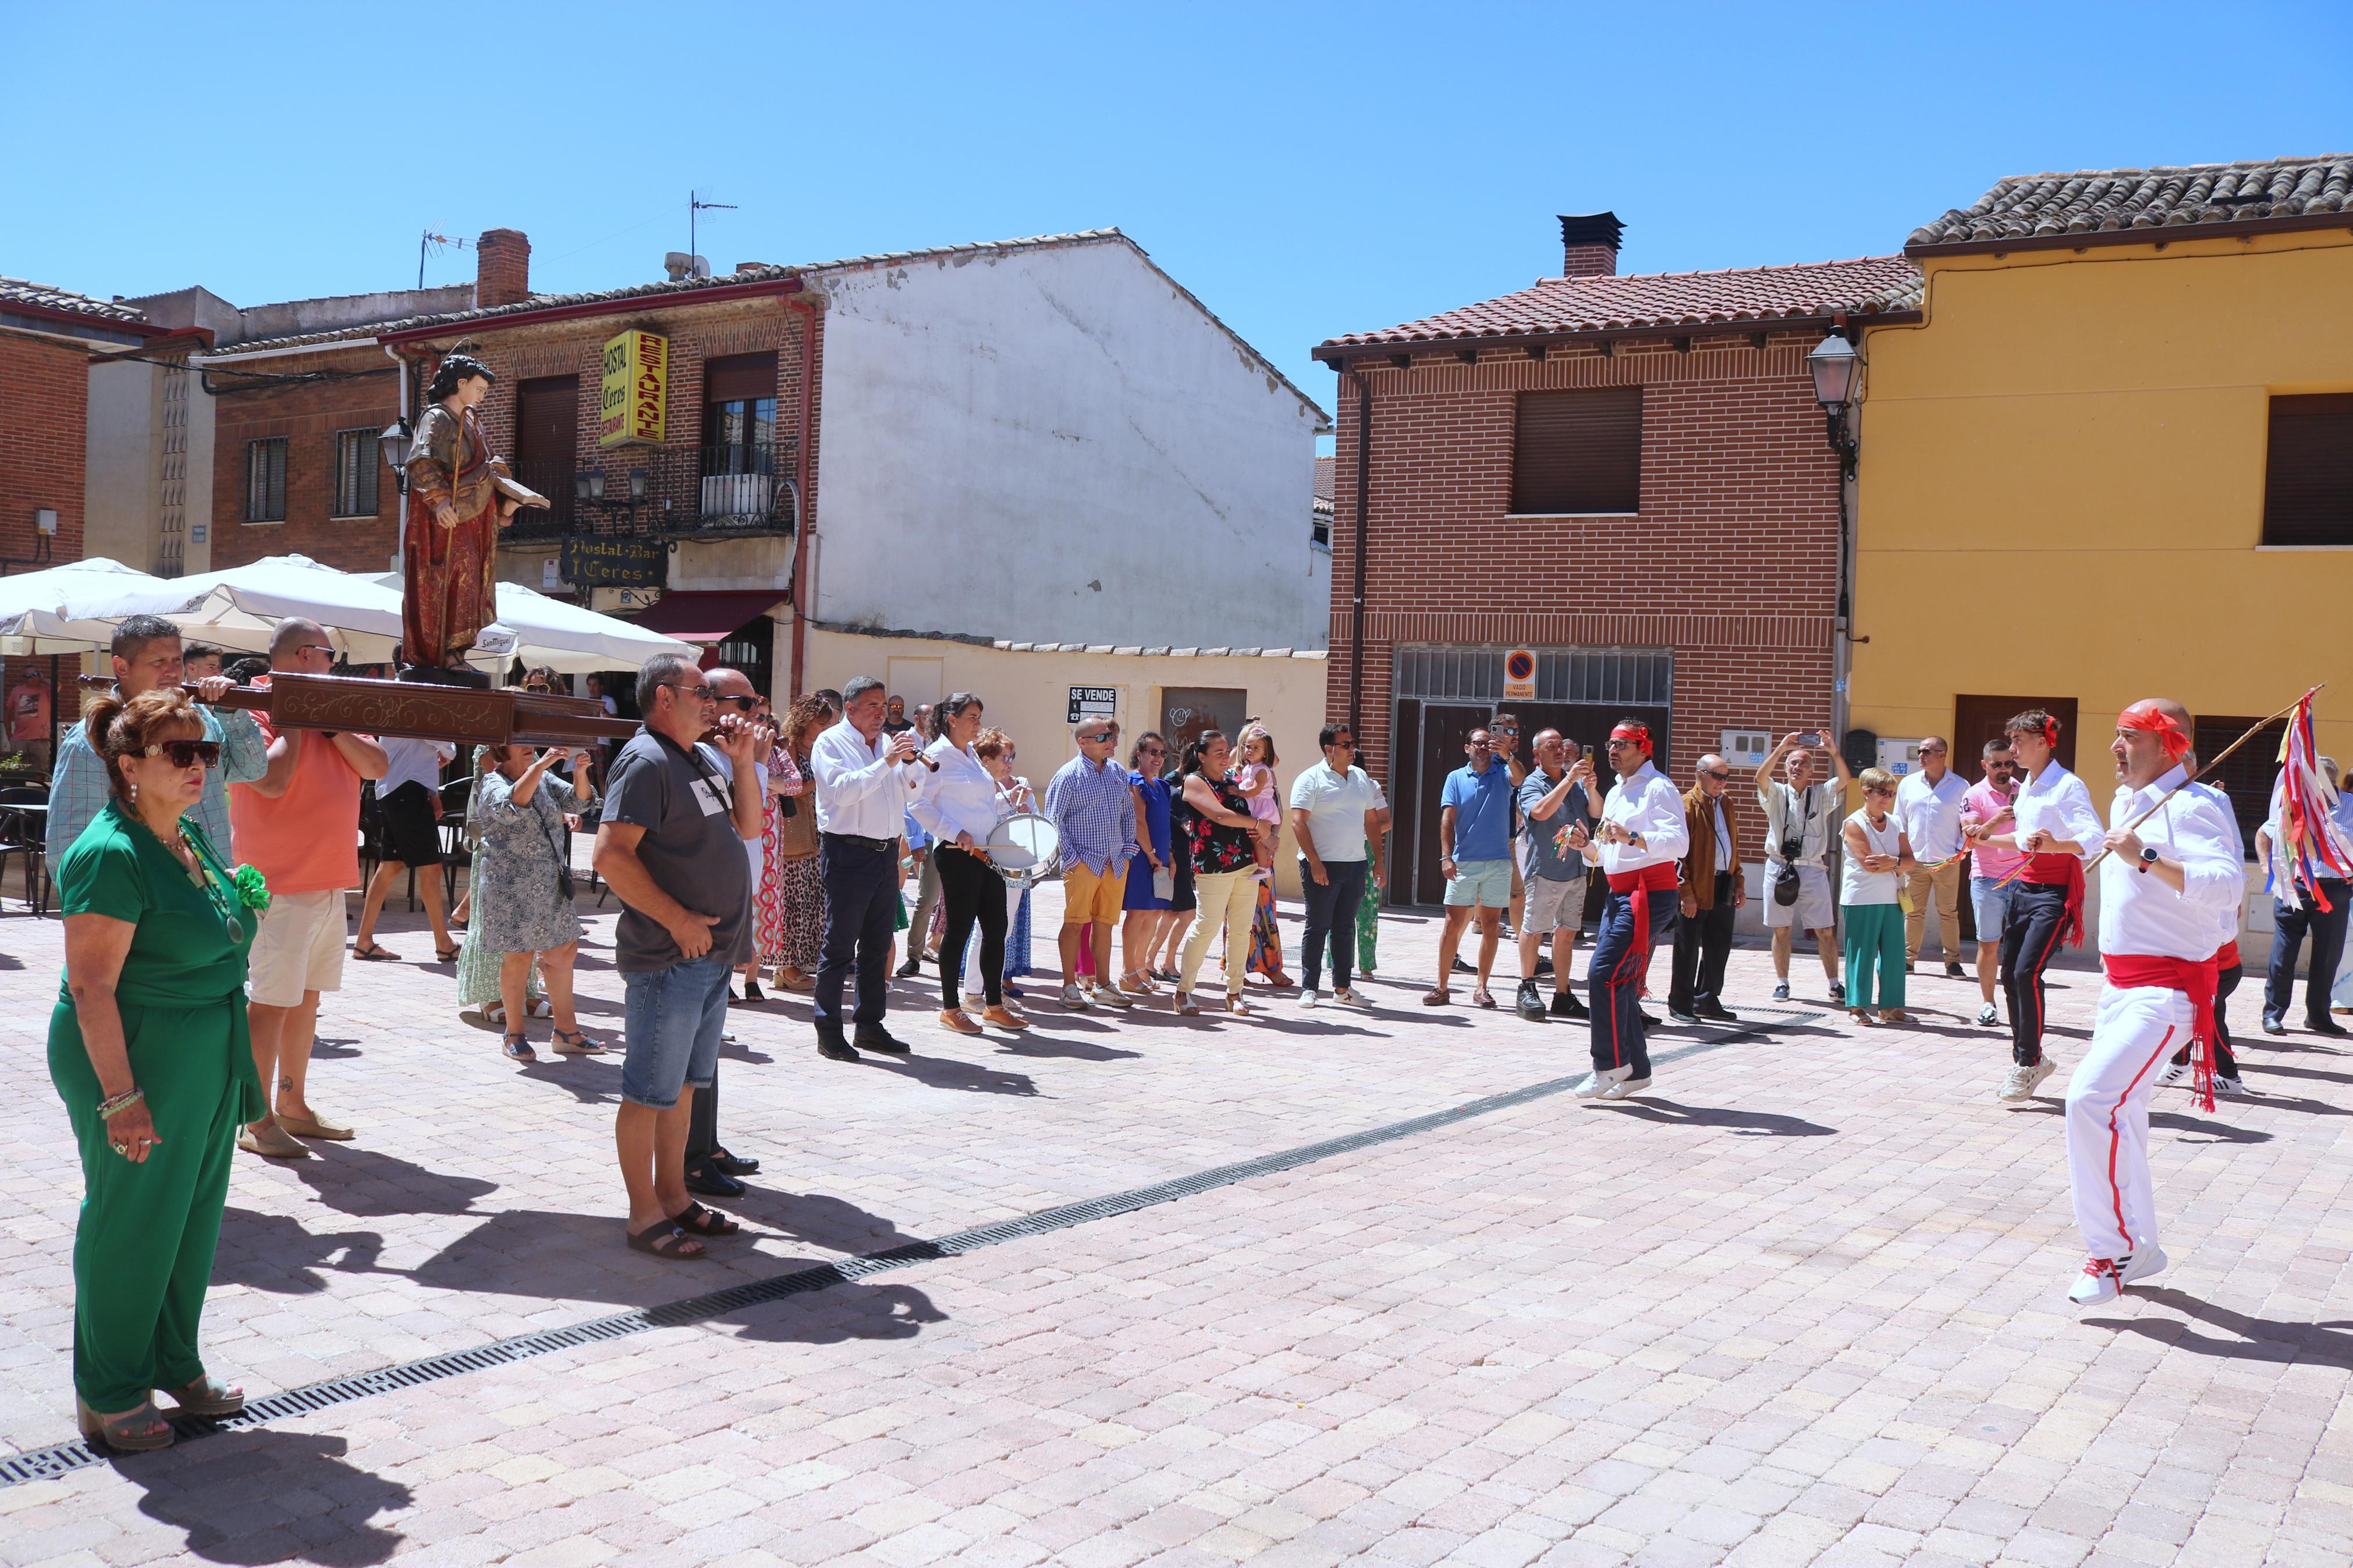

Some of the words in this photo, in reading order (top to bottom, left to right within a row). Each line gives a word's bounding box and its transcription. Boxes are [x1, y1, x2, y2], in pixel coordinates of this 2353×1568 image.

[604, 342, 626, 378] HOSTAL
[603, 386, 625, 410] Ceres
[637, 333, 662, 440] RESTAURANTE
[601, 412, 624, 438] RESTAURANTE
[584, 560, 643, 580] Ceres
[1071, 689, 1083, 700] SE
[1085, 689, 1115, 701] VENDE
